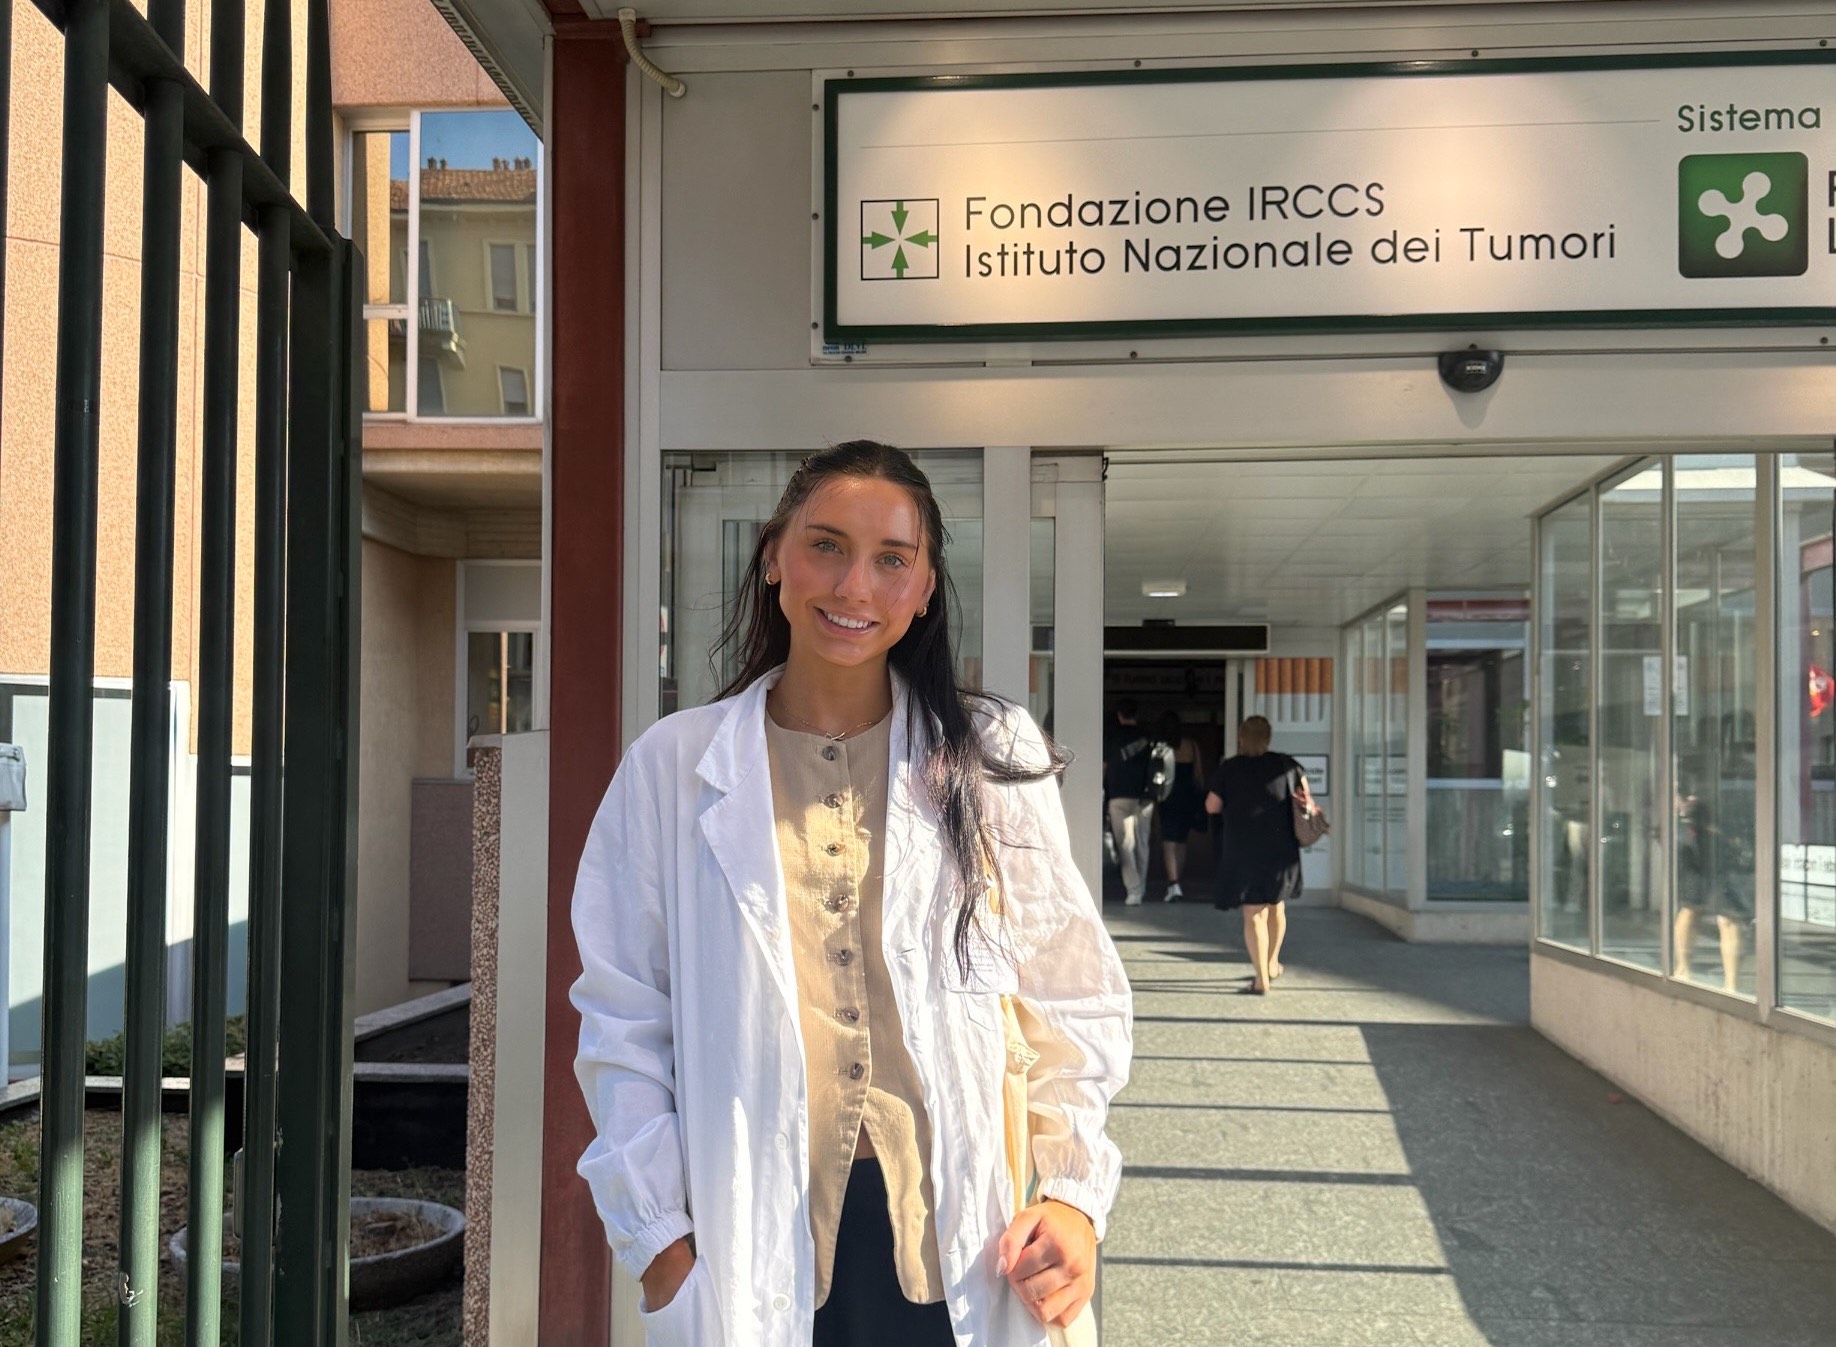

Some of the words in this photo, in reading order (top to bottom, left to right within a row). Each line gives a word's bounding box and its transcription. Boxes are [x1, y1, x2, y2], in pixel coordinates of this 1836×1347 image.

[1678, 104, 1820, 132] Sistema
[967, 191, 1229, 230] Fondazione
[1248, 182, 1385, 221] IRCCS
[966, 241, 1105, 277] Istituto
[1125, 232, 1353, 273] Nazionale
[1371, 229, 1440, 264] dei
[1460, 224, 1614, 261] Tumori
